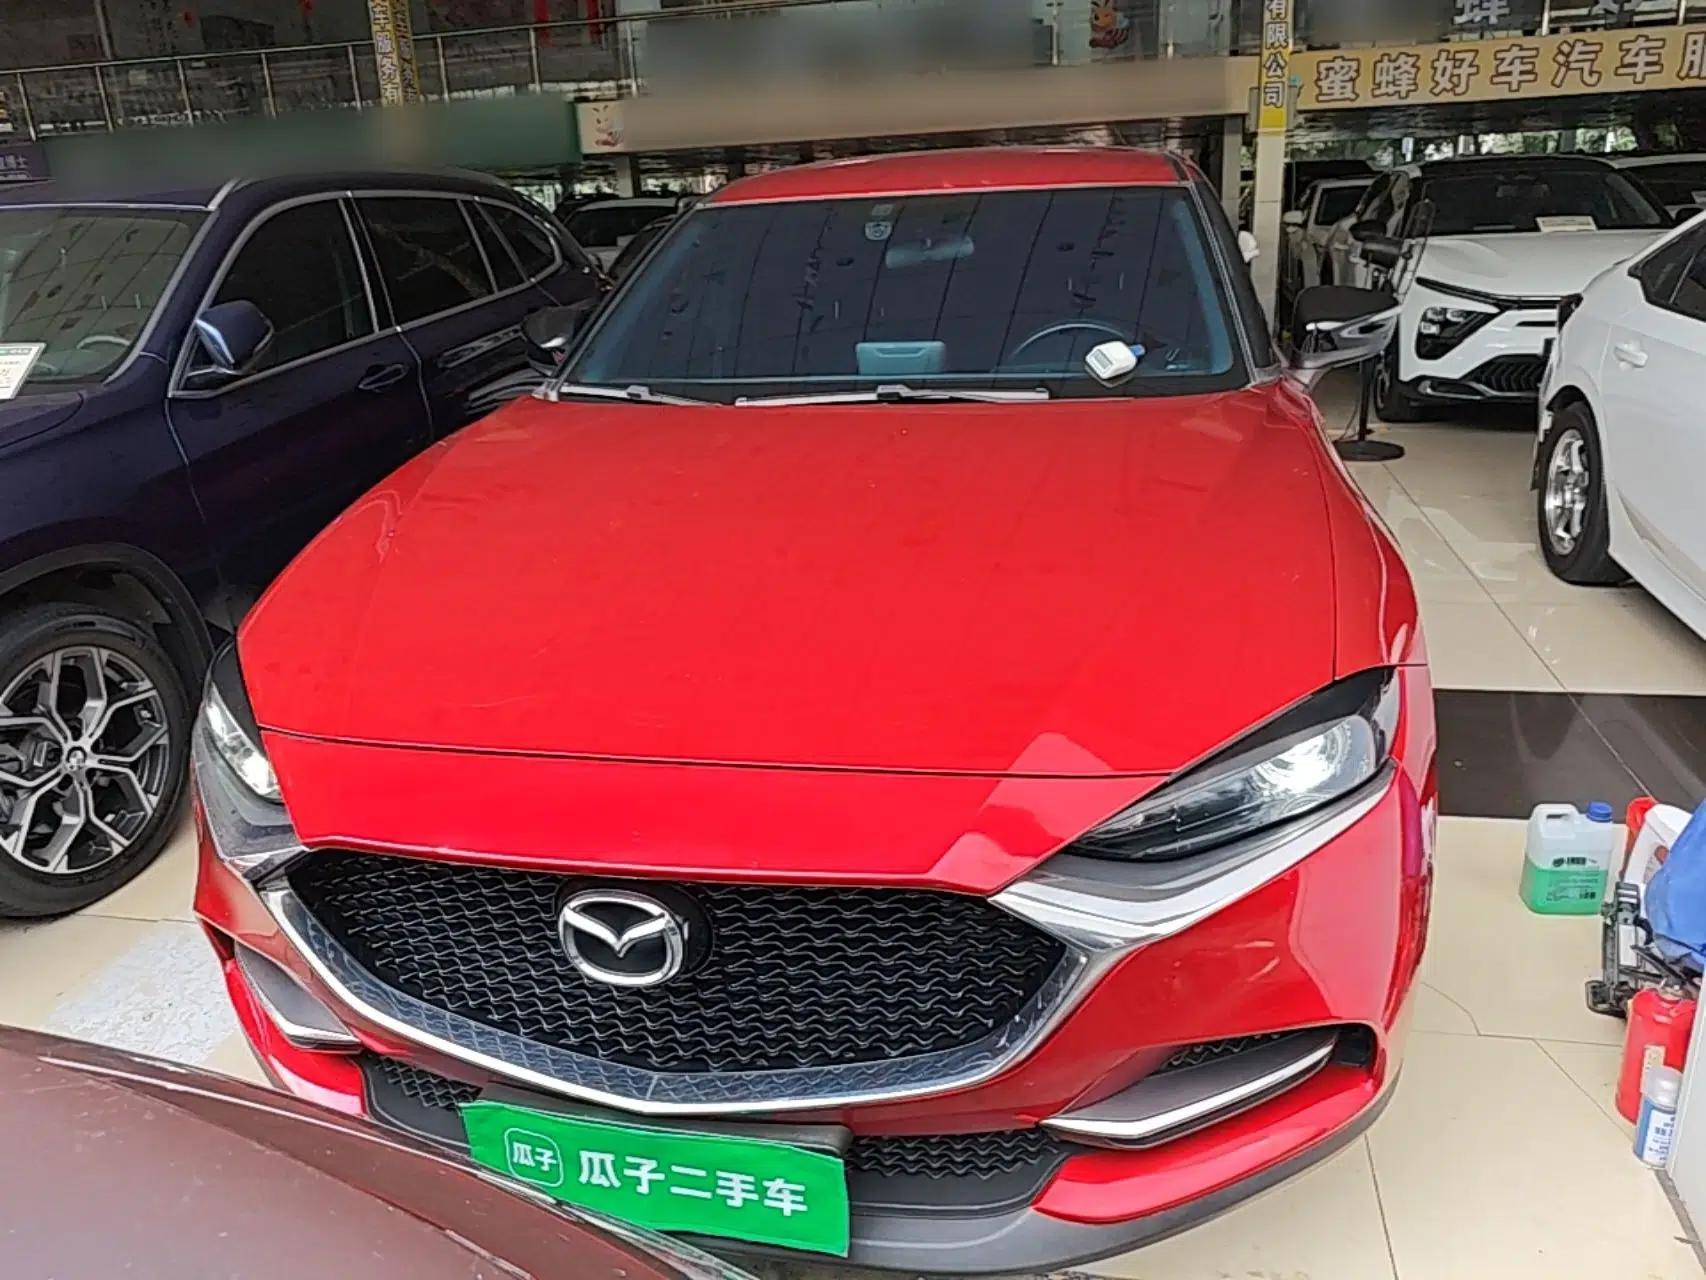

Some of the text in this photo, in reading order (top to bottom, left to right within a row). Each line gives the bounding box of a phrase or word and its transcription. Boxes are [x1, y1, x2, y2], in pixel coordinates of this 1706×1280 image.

[1264, 0, 1288, 108] 有限公司
[512, 1141, 558, 1172] 瓜子
[578, 1150, 808, 1217] 瓜子二手车
